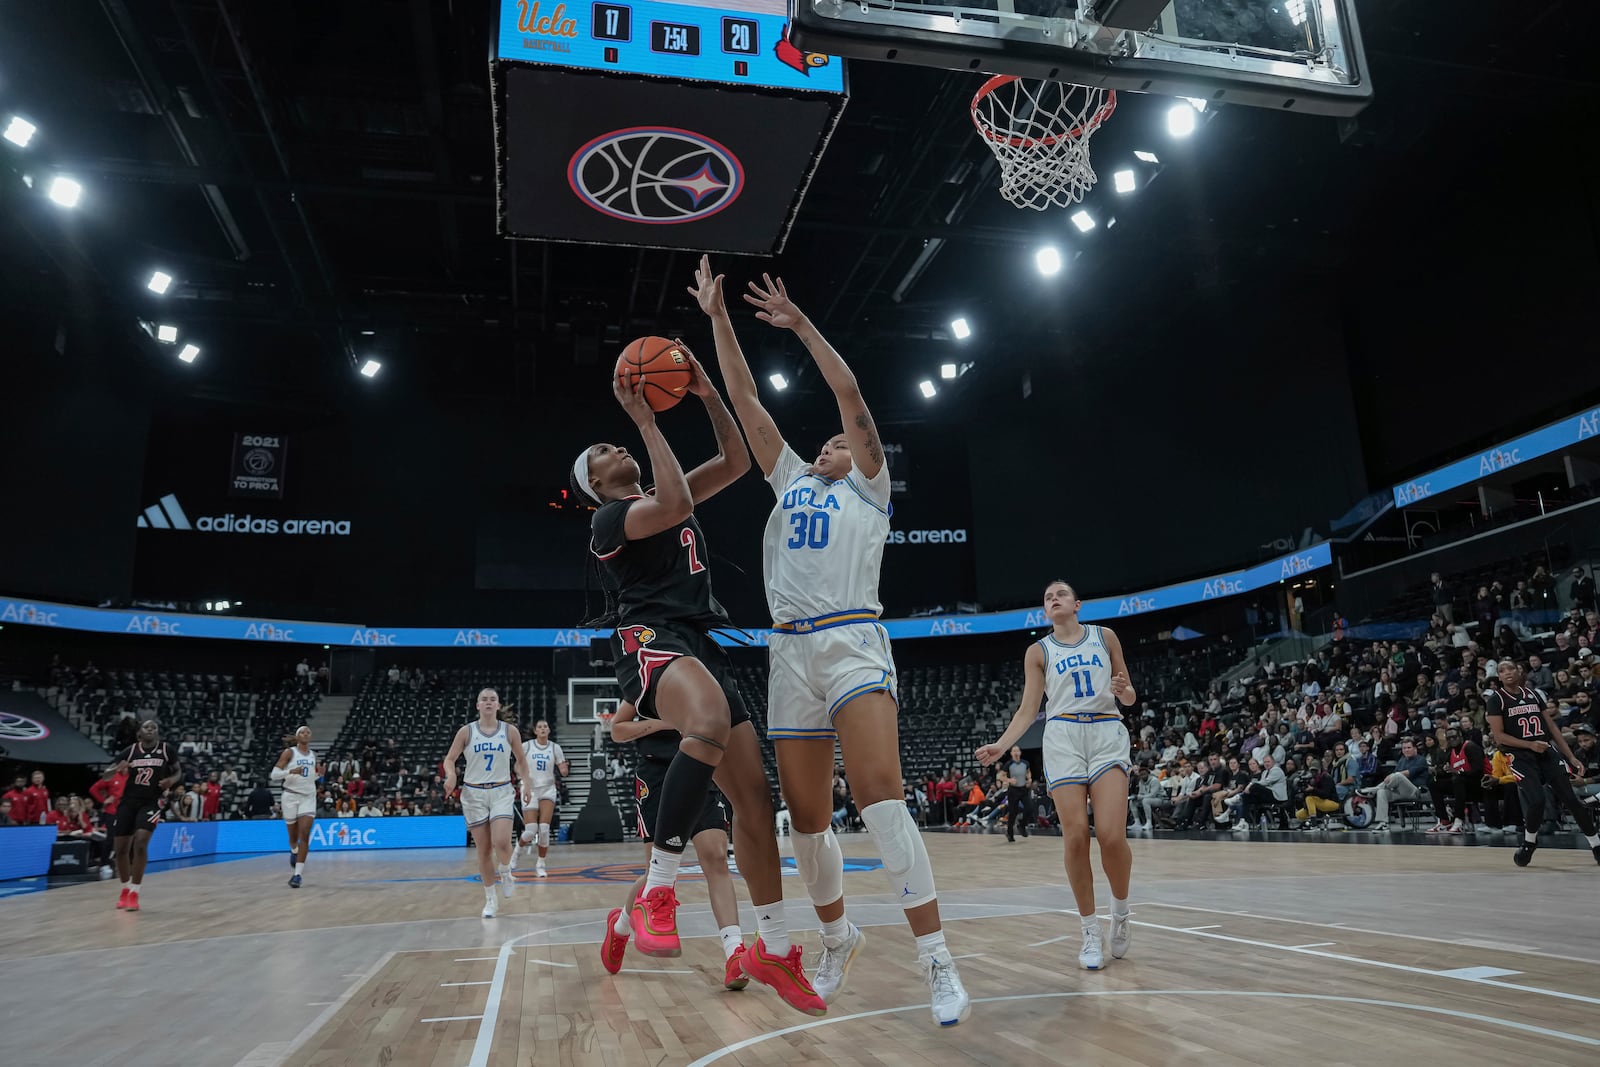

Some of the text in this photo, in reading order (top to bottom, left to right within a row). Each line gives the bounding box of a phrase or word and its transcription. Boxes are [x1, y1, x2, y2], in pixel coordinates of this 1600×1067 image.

[516, 0, 578, 38] Ucla
[605, 9, 619, 36] 17
[663, 26, 689, 51] 7:54
[731, 24, 750, 50] 20
[242, 435, 280, 448] 2021
[1479, 447, 1521, 477] Aflac
[233, 480, 279, 491] TO PRO A
[1396, 481, 1431, 506] Aflac
[782, 487, 840, 511] UCLA
[196, 513, 350, 535] adidas arena
[787, 511, 830, 549] 30
[908, 529, 967, 543] arena
[680, 527, 706, 575] 2
[1281, 555, 1313, 577] Aflac
[1202, 578, 1243, 599] Aflac
[1, 603, 58, 625] Aflac
[1118, 596, 1155, 616] Aflac
[126, 615, 181, 635] Aflac
[244, 623, 294, 641] Aflac
[930, 618, 972, 636] Aflac
[351, 629, 397, 646] Aflac
[454, 630, 499, 646] Aflac
[1055, 653, 1103, 675] UCLA
[1071, 670, 1095, 698] 11
[1518, 715, 1545, 738] 22
[474, 742, 504, 753] UCLA
[483, 754, 494, 771] 7
[134, 767, 150, 786] 12
[309, 822, 377, 846] Aflac
